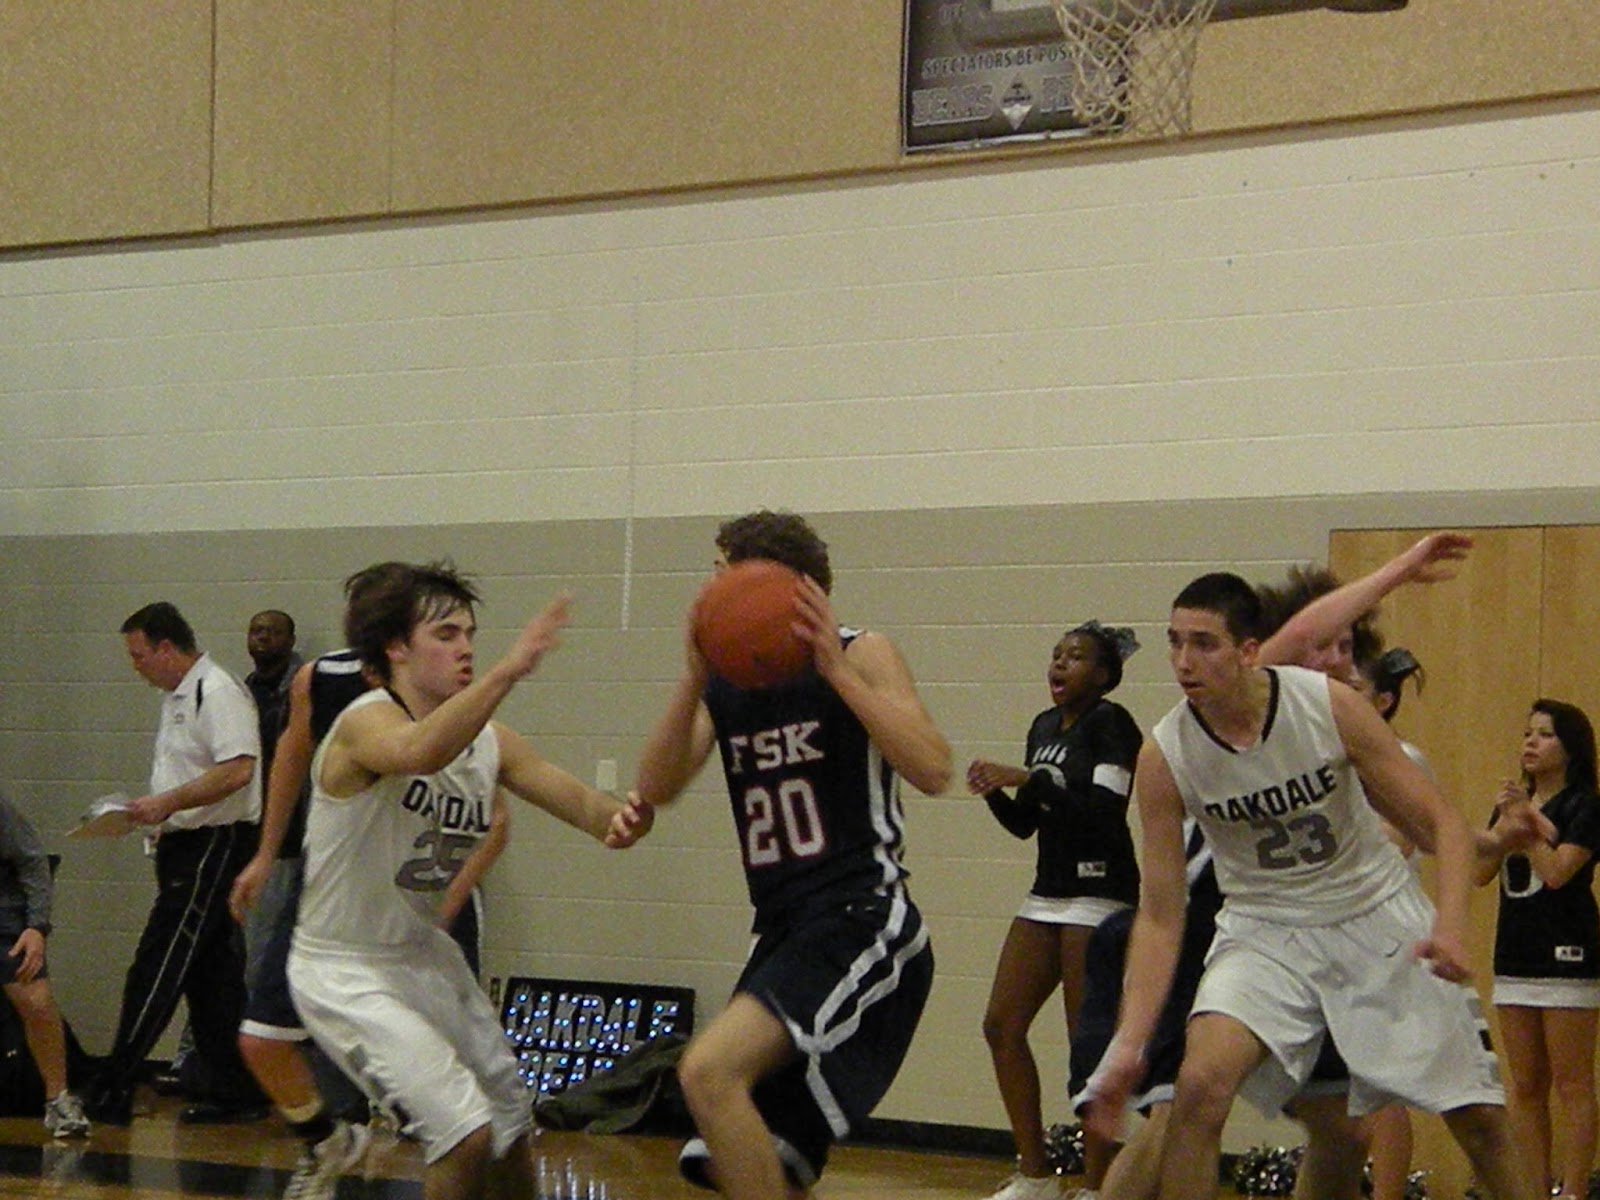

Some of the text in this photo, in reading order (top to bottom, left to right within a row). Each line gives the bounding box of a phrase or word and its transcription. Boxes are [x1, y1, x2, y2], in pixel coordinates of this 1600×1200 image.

[922, 50, 1011, 79] SPECTATORS
[1016, 48, 1032, 66] BE
[729, 721, 824, 774] FSK
[744, 778, 825, 864] 20
[1205, 764, 1337, 822] OAKDALE
[395, 830, 479, 892] 25
[1252, 814, 1337, 869] 23
[501, 988, 680, 1056] OAKDALE
